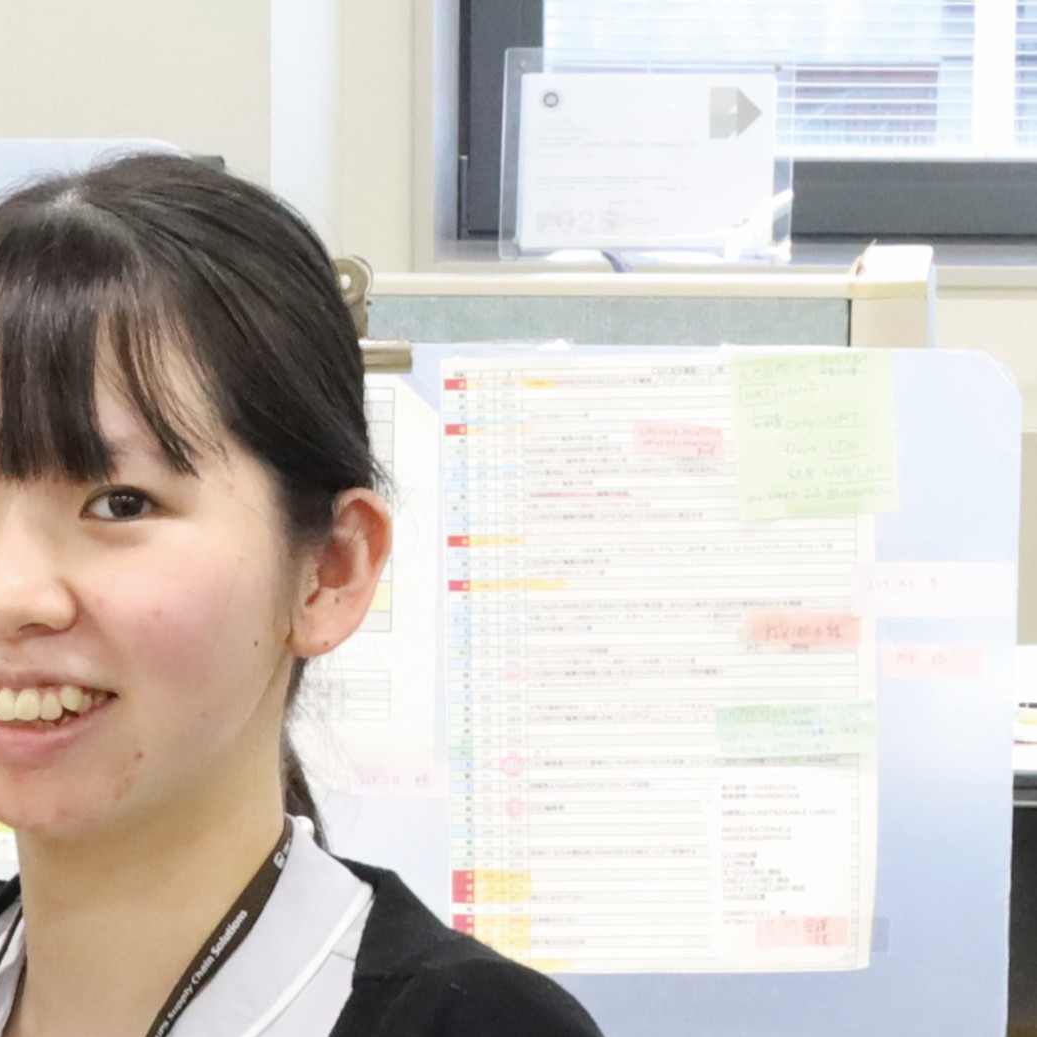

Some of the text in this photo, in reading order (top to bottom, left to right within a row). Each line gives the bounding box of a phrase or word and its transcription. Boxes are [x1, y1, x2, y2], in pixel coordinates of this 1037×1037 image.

[167, 983, 194, 1020] Supply
[191, 954, 214, 985] Chain
[210, 910, 248, 956] Solutions
